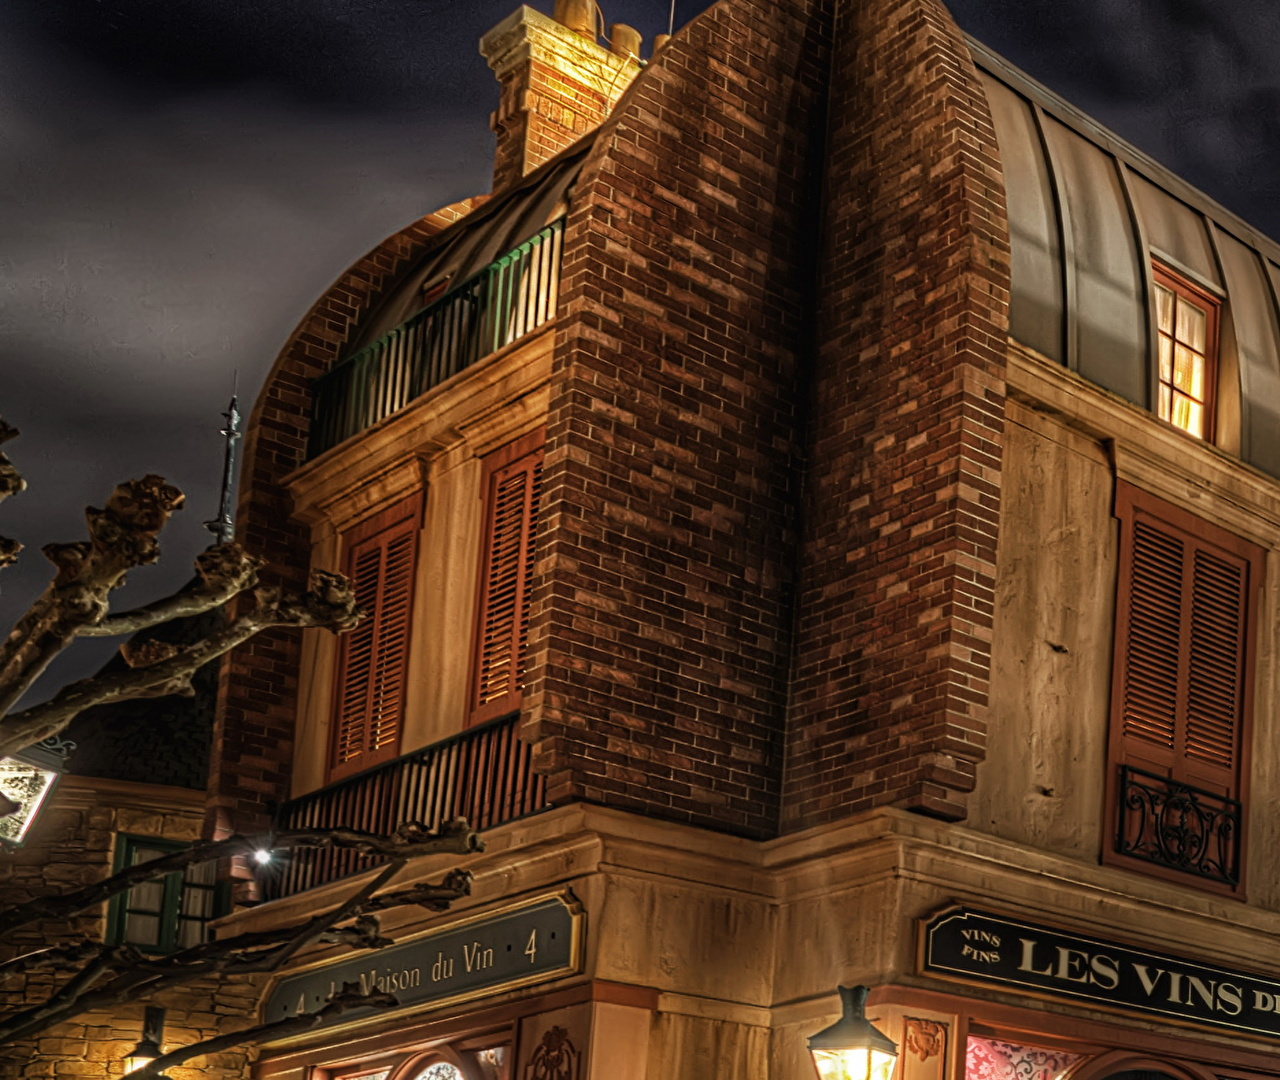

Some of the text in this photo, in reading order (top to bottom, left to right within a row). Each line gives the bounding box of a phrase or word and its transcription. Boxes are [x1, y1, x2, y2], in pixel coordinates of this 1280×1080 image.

[360, 966, 420, 996] Maison
[432, 953, 453, 982] du
[463, 941, 494, 972] Vin
[524, 929, 537, 963] 4
[960, 928, 1001, 948] VINS
[1018, 938, 1120, 991] LES
[1132, 963, 1243, 1016] VINS
